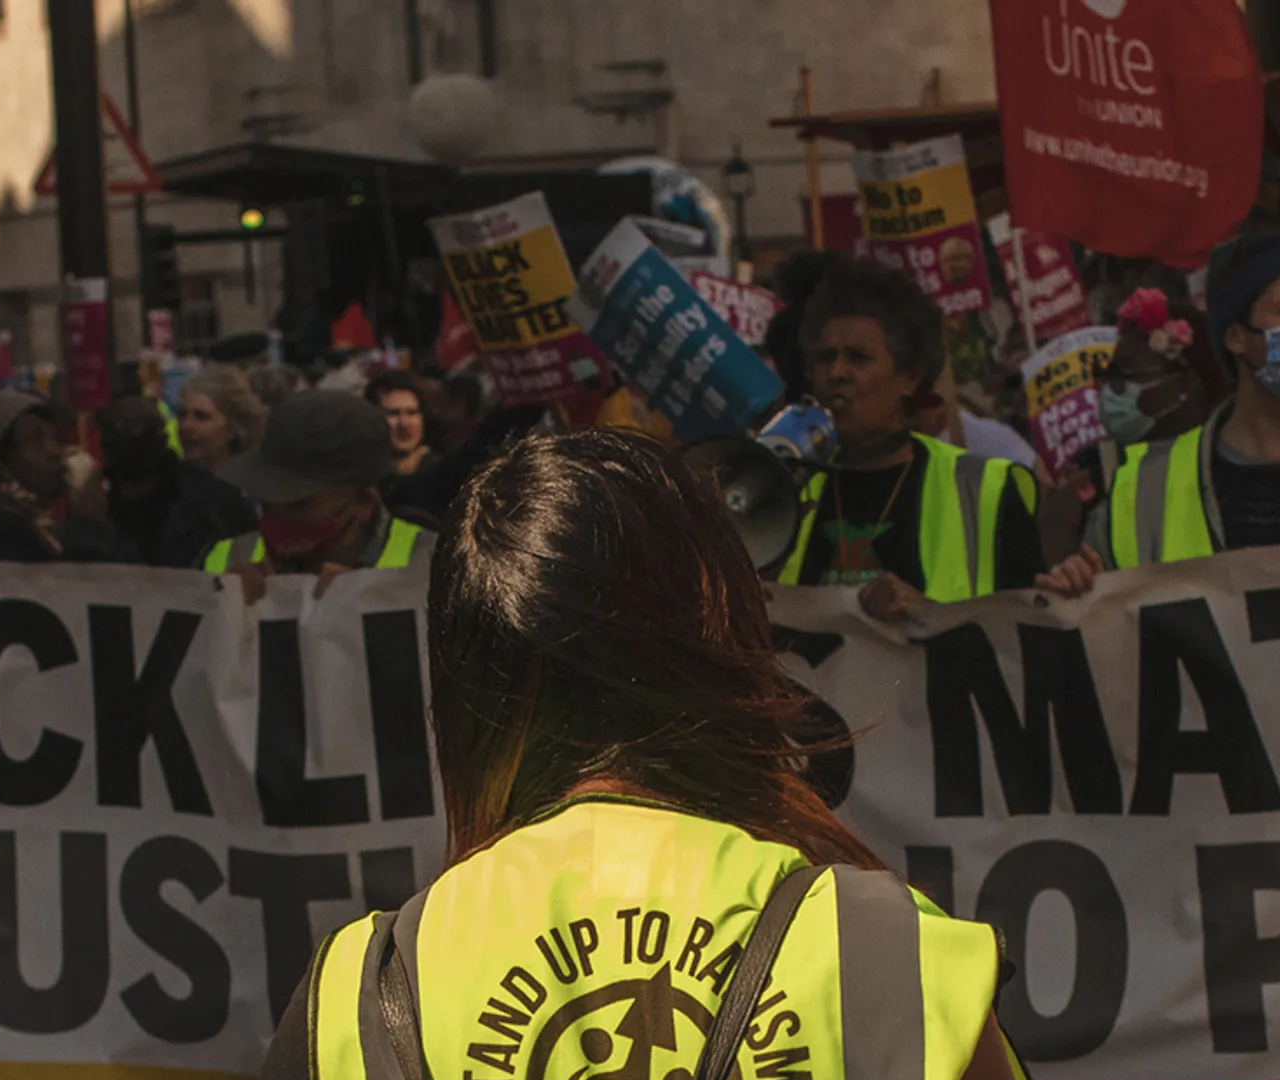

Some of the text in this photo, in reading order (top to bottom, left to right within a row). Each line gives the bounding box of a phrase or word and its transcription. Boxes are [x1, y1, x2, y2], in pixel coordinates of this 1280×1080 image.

[1095, 99, 1163, 130] UNION
[1036, 361, 1070, 388] No
[535, 917, 599, 985] UP
[616, 907, 670, 965] TO
[905, 839, 1128, 1062] O
